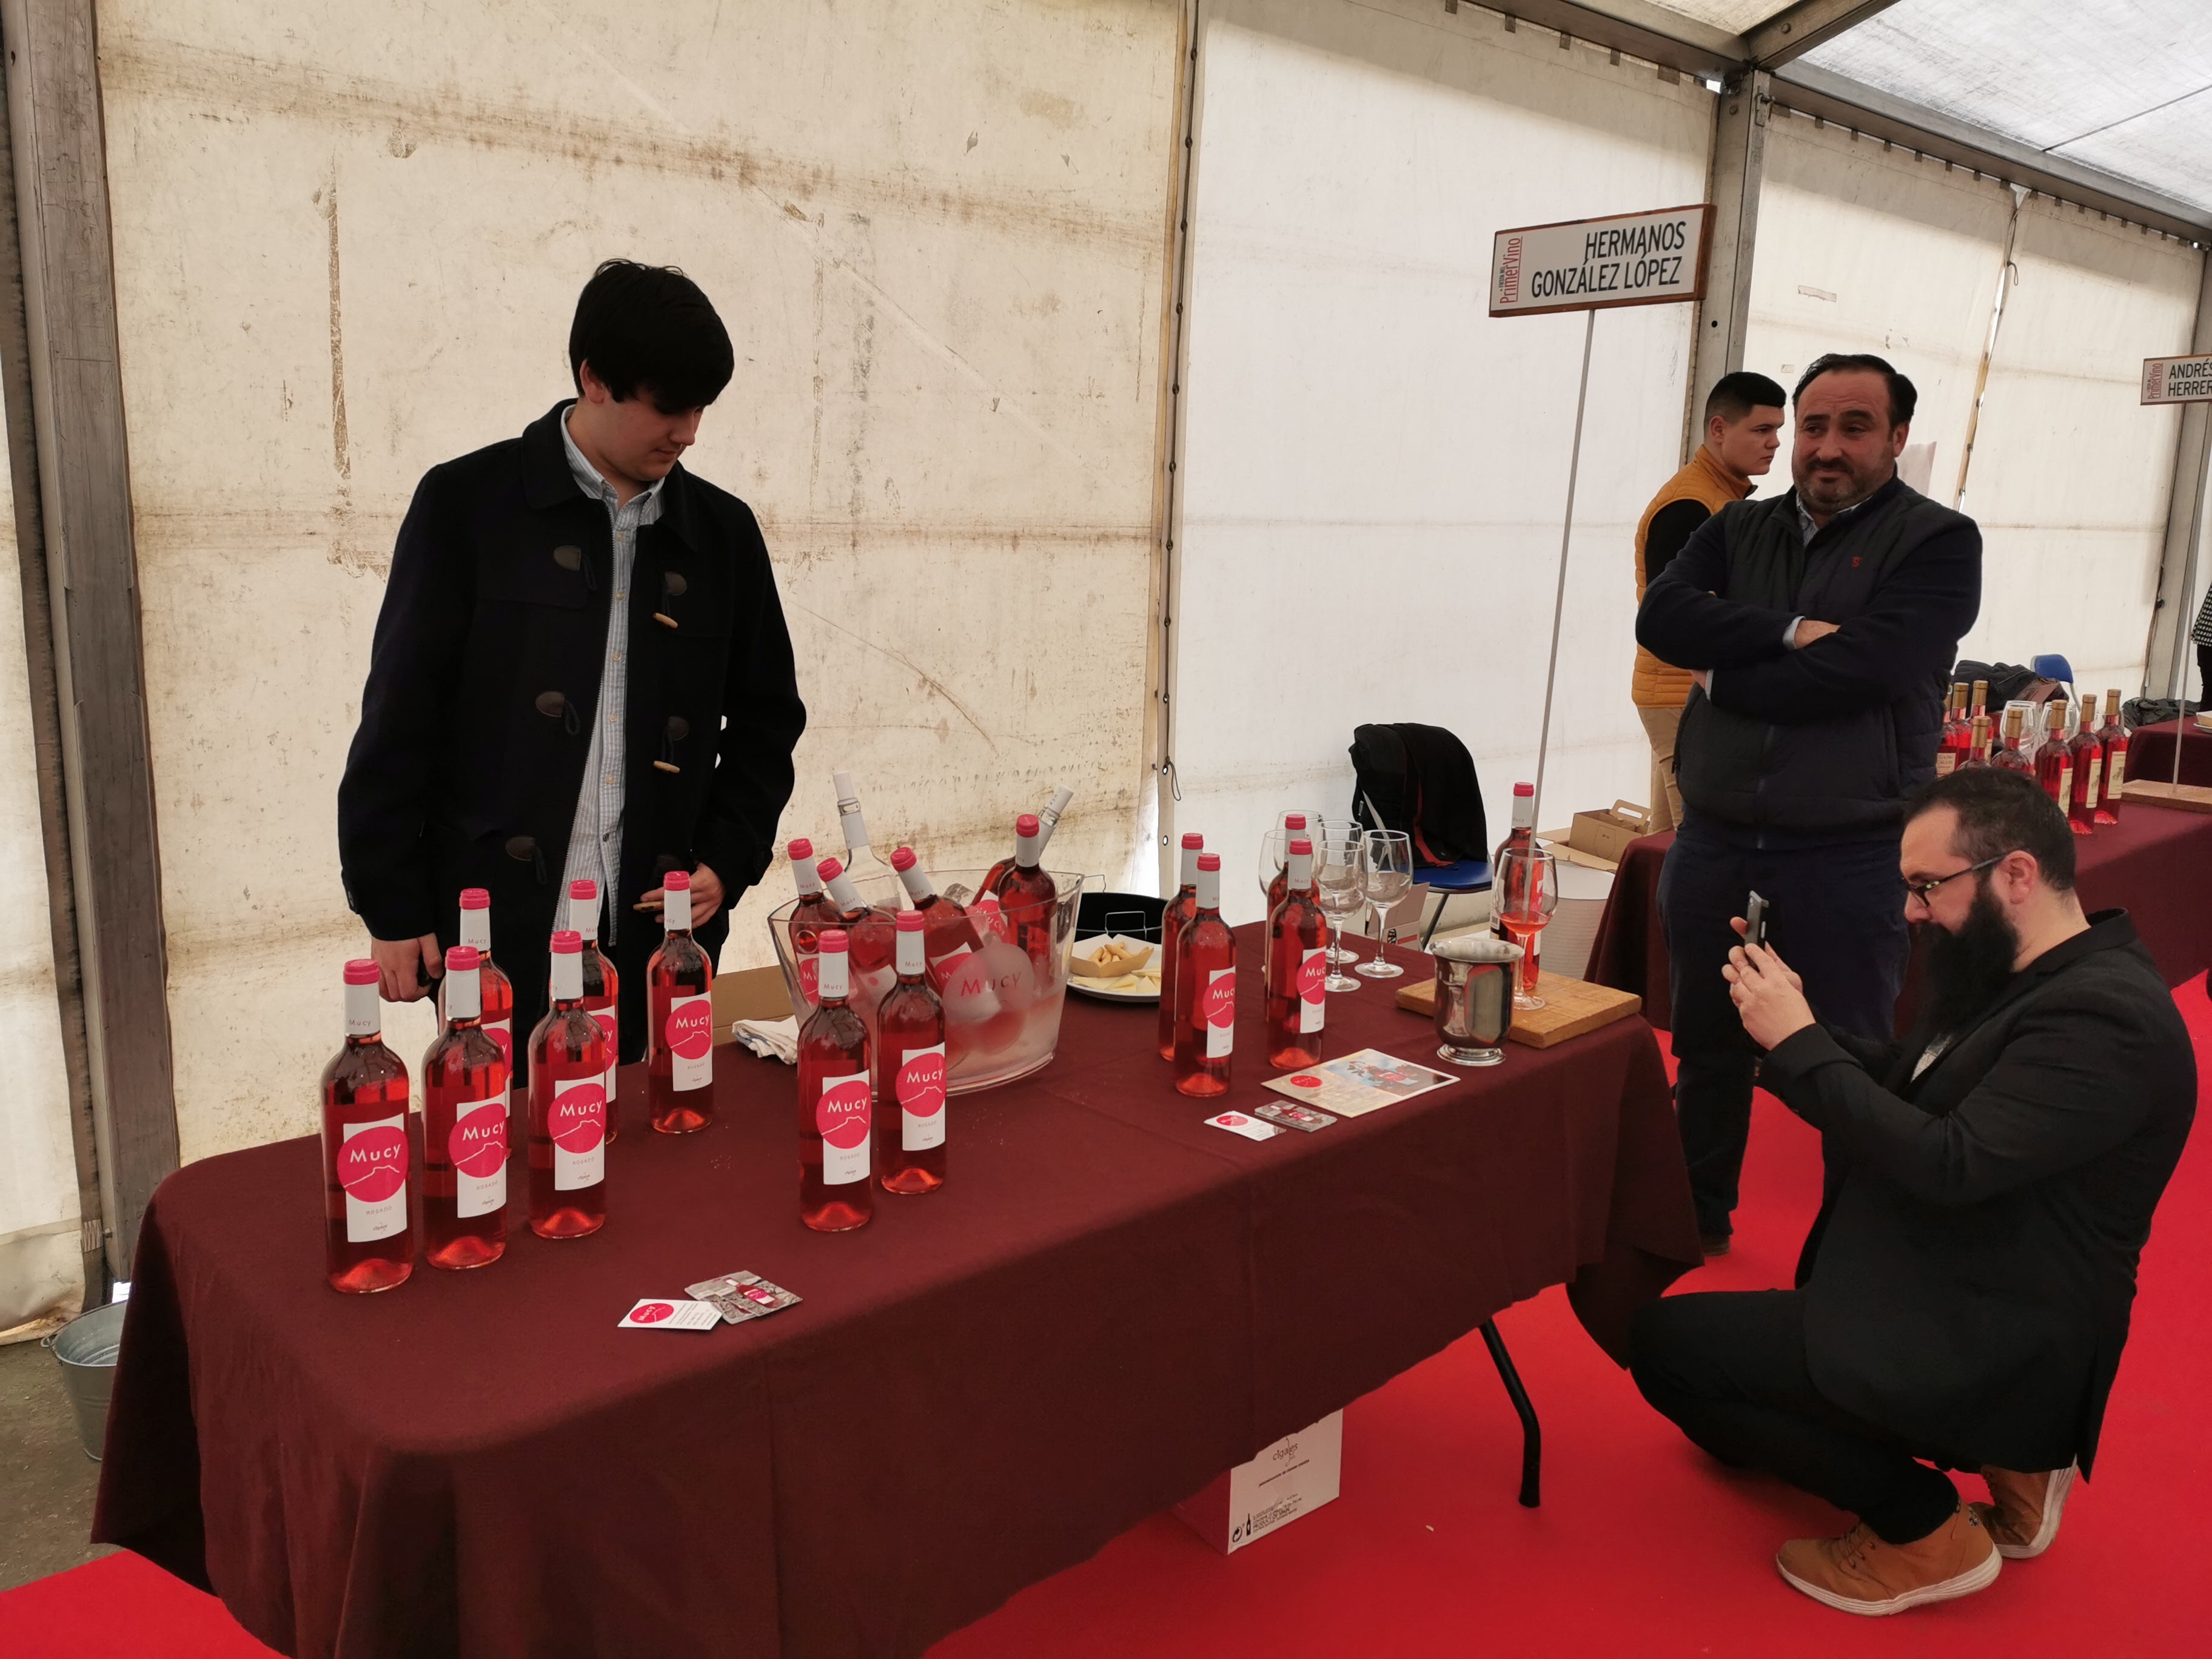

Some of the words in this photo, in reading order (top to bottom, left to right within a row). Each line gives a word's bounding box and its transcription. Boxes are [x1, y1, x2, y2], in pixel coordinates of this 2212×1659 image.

[1585, 221, 1687, 260] HERMANOS
[1532, 258, 1621, 298] GONZÁLEZ
[1624, 252, 1683, 289] LÓPEZ
[1305, 967, 1326, 977] Muc
[1212, 988, 1235, 1000] Muc
[675, 1014, 710, 1029] Mucy
[906, 1068, 943, 1084] Mucy
[560, 1100, 602, 1117] Mucy
[827, 1096, 867, 1113] Mucy
[462, 1120, 504, 1141] Mucy
[350, 1144, 401, 1164] Mucy
